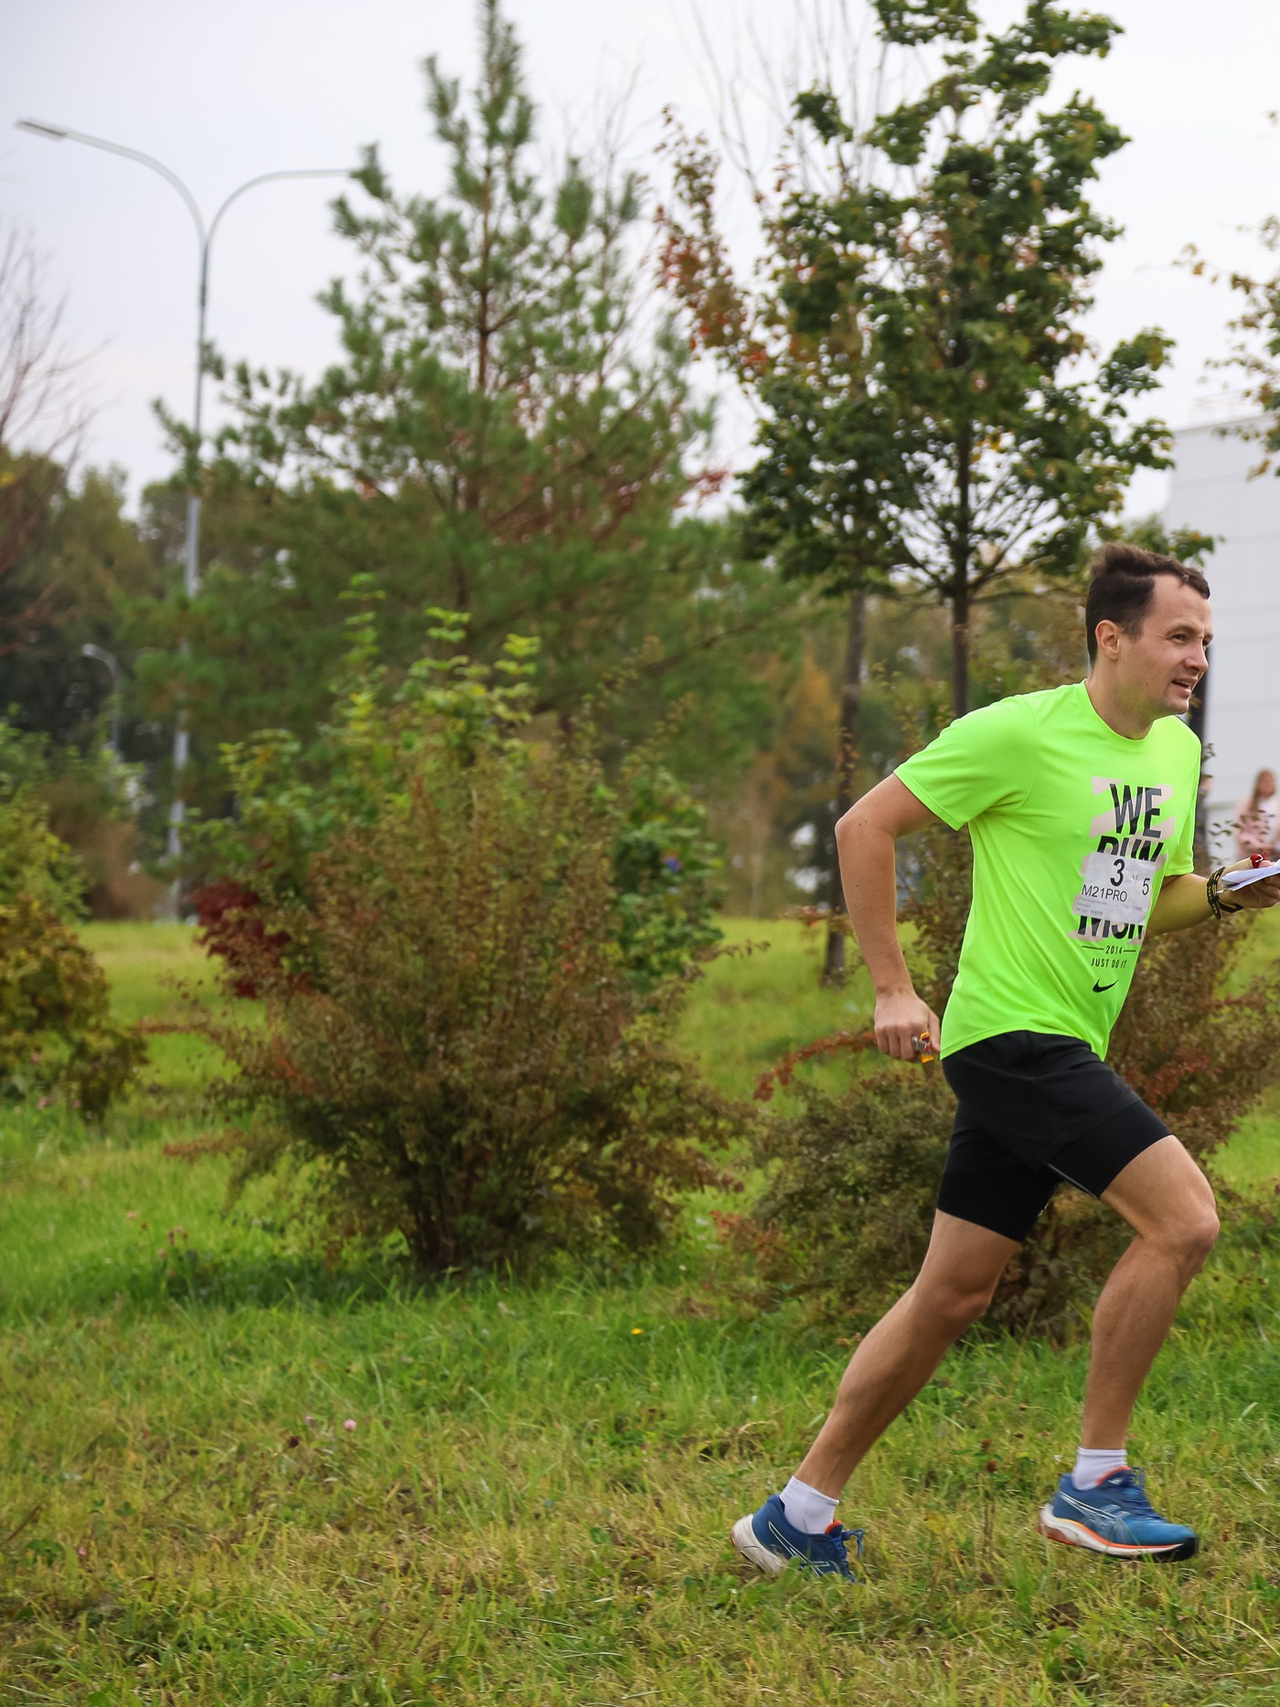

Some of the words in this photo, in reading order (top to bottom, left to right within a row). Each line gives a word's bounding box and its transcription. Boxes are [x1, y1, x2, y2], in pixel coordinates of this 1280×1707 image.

[1109, 783, 1162, 838] WE
[1109, 858, 1126, 887] 3
[1081, 884, 1128, 903] M21PRO
[1141, 877, 1151, 896] 5
[1105, 945, 1123, 955] 2014
[1091, 958, 1110, 968] JUST
[1111, 959, 1120, 969] DO
